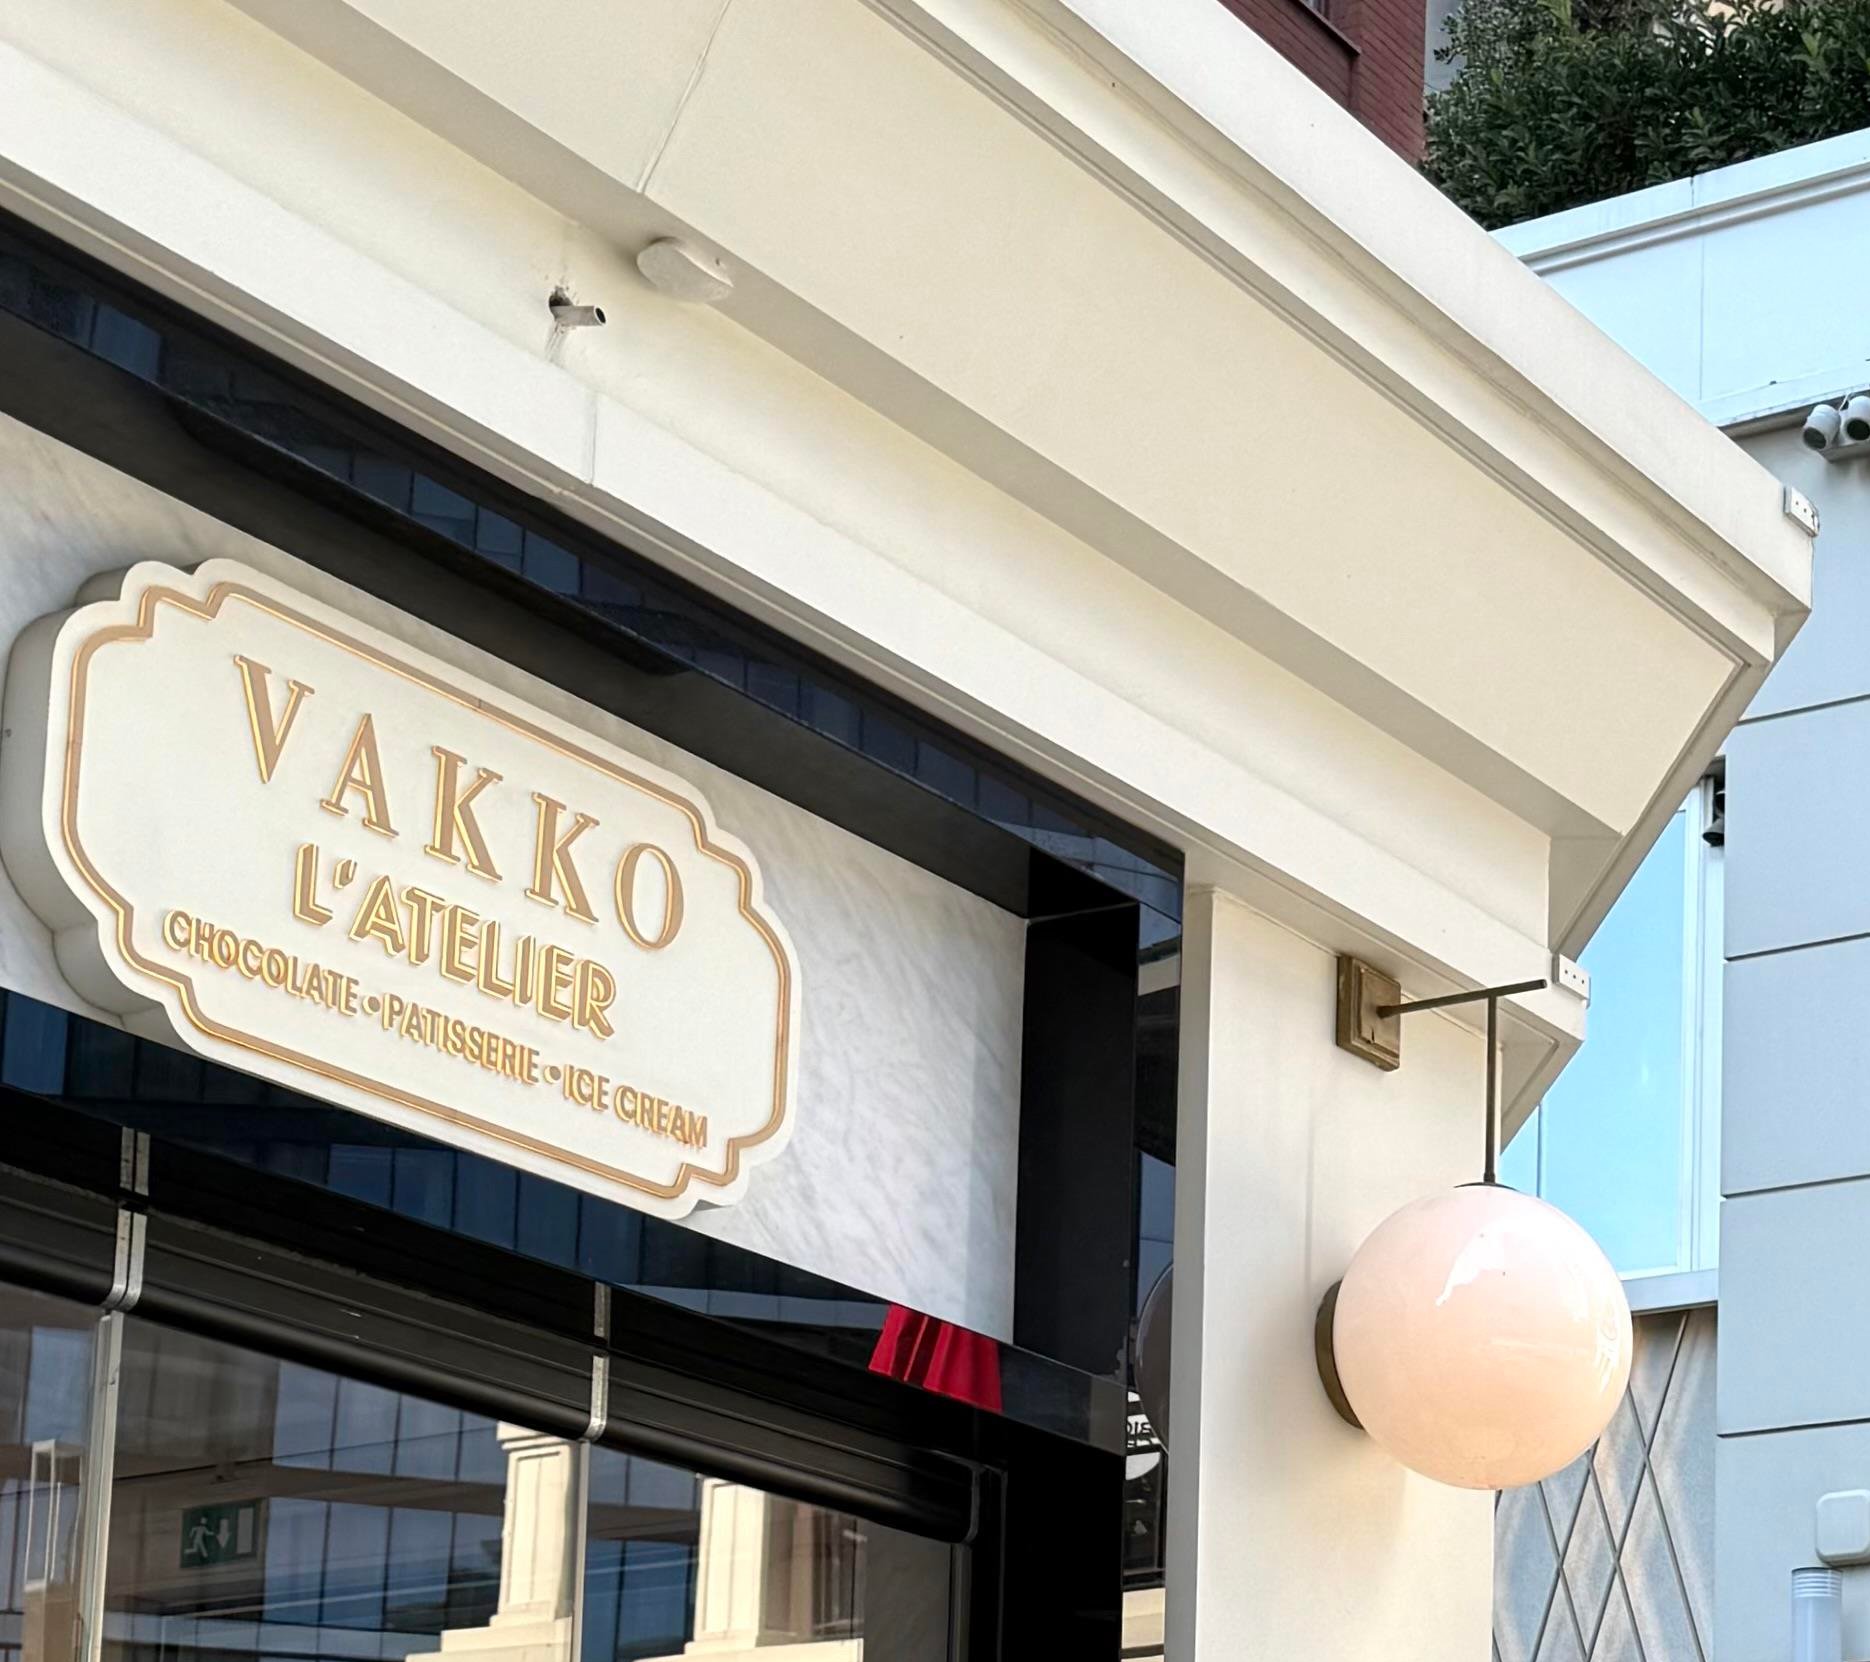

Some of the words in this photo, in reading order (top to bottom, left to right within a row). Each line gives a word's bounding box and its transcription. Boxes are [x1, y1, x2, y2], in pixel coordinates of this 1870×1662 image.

[235, 655, 685, 950] VAKKO
[163, 910, 359, 1016] CHOCOLATE
[381, 993, 540, 1085] PATISSERIE
[562, 1063, 610, 1112] ICE
[614, 1085, 708, 1148] CREAM
[293, 843, 617, 1039] L'ATELIER
